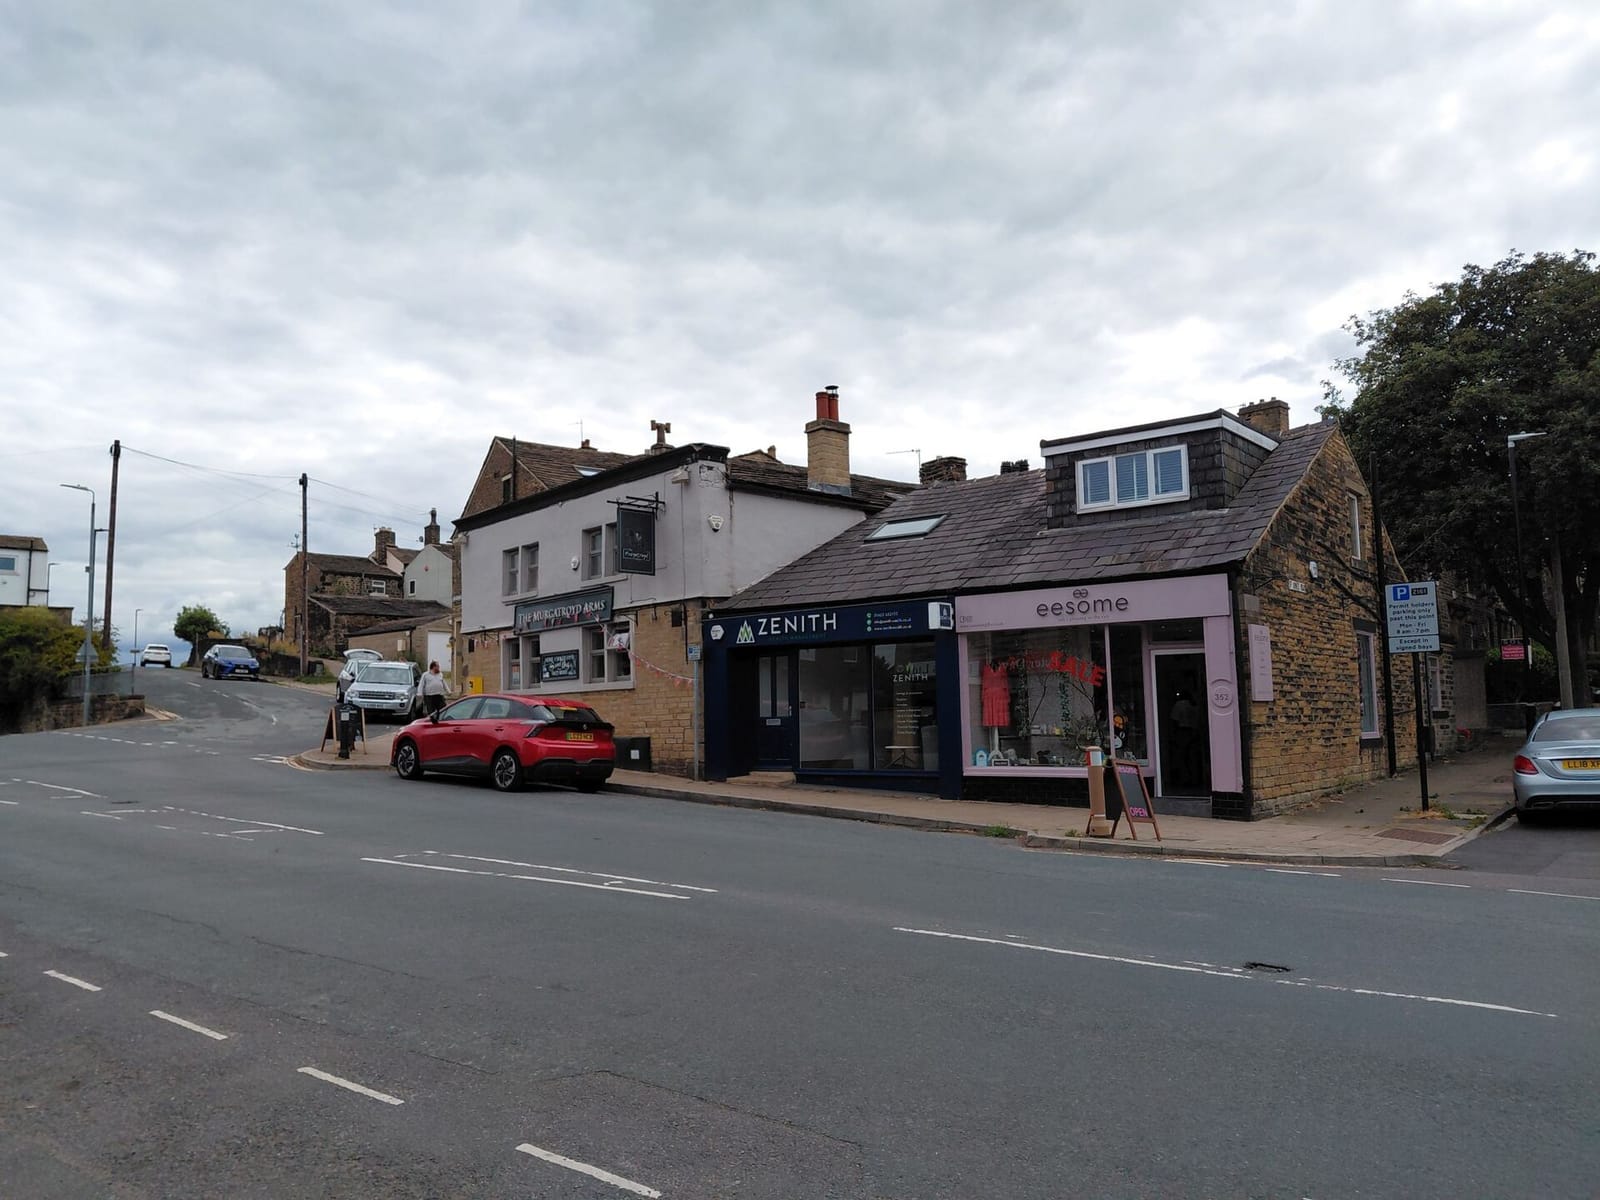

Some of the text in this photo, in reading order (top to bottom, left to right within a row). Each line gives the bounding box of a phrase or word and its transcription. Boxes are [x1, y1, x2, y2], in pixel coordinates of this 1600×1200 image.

[1396, 587, 1407, 599] P
[518, 599, 606, 625] THE MURGATROYD ARMS
[1036, 597, 1128, 617] eesome
[757, 612, 837, 636] ZENITH
[1049, 649, 1105, 687] SALE
[892, 673, 928, 682] ZENITH
[1214, 693, 1229, 701] 352
[1567, 760, 1588, 769] LL18
[1129, 806, 1148, 817] OPEN
